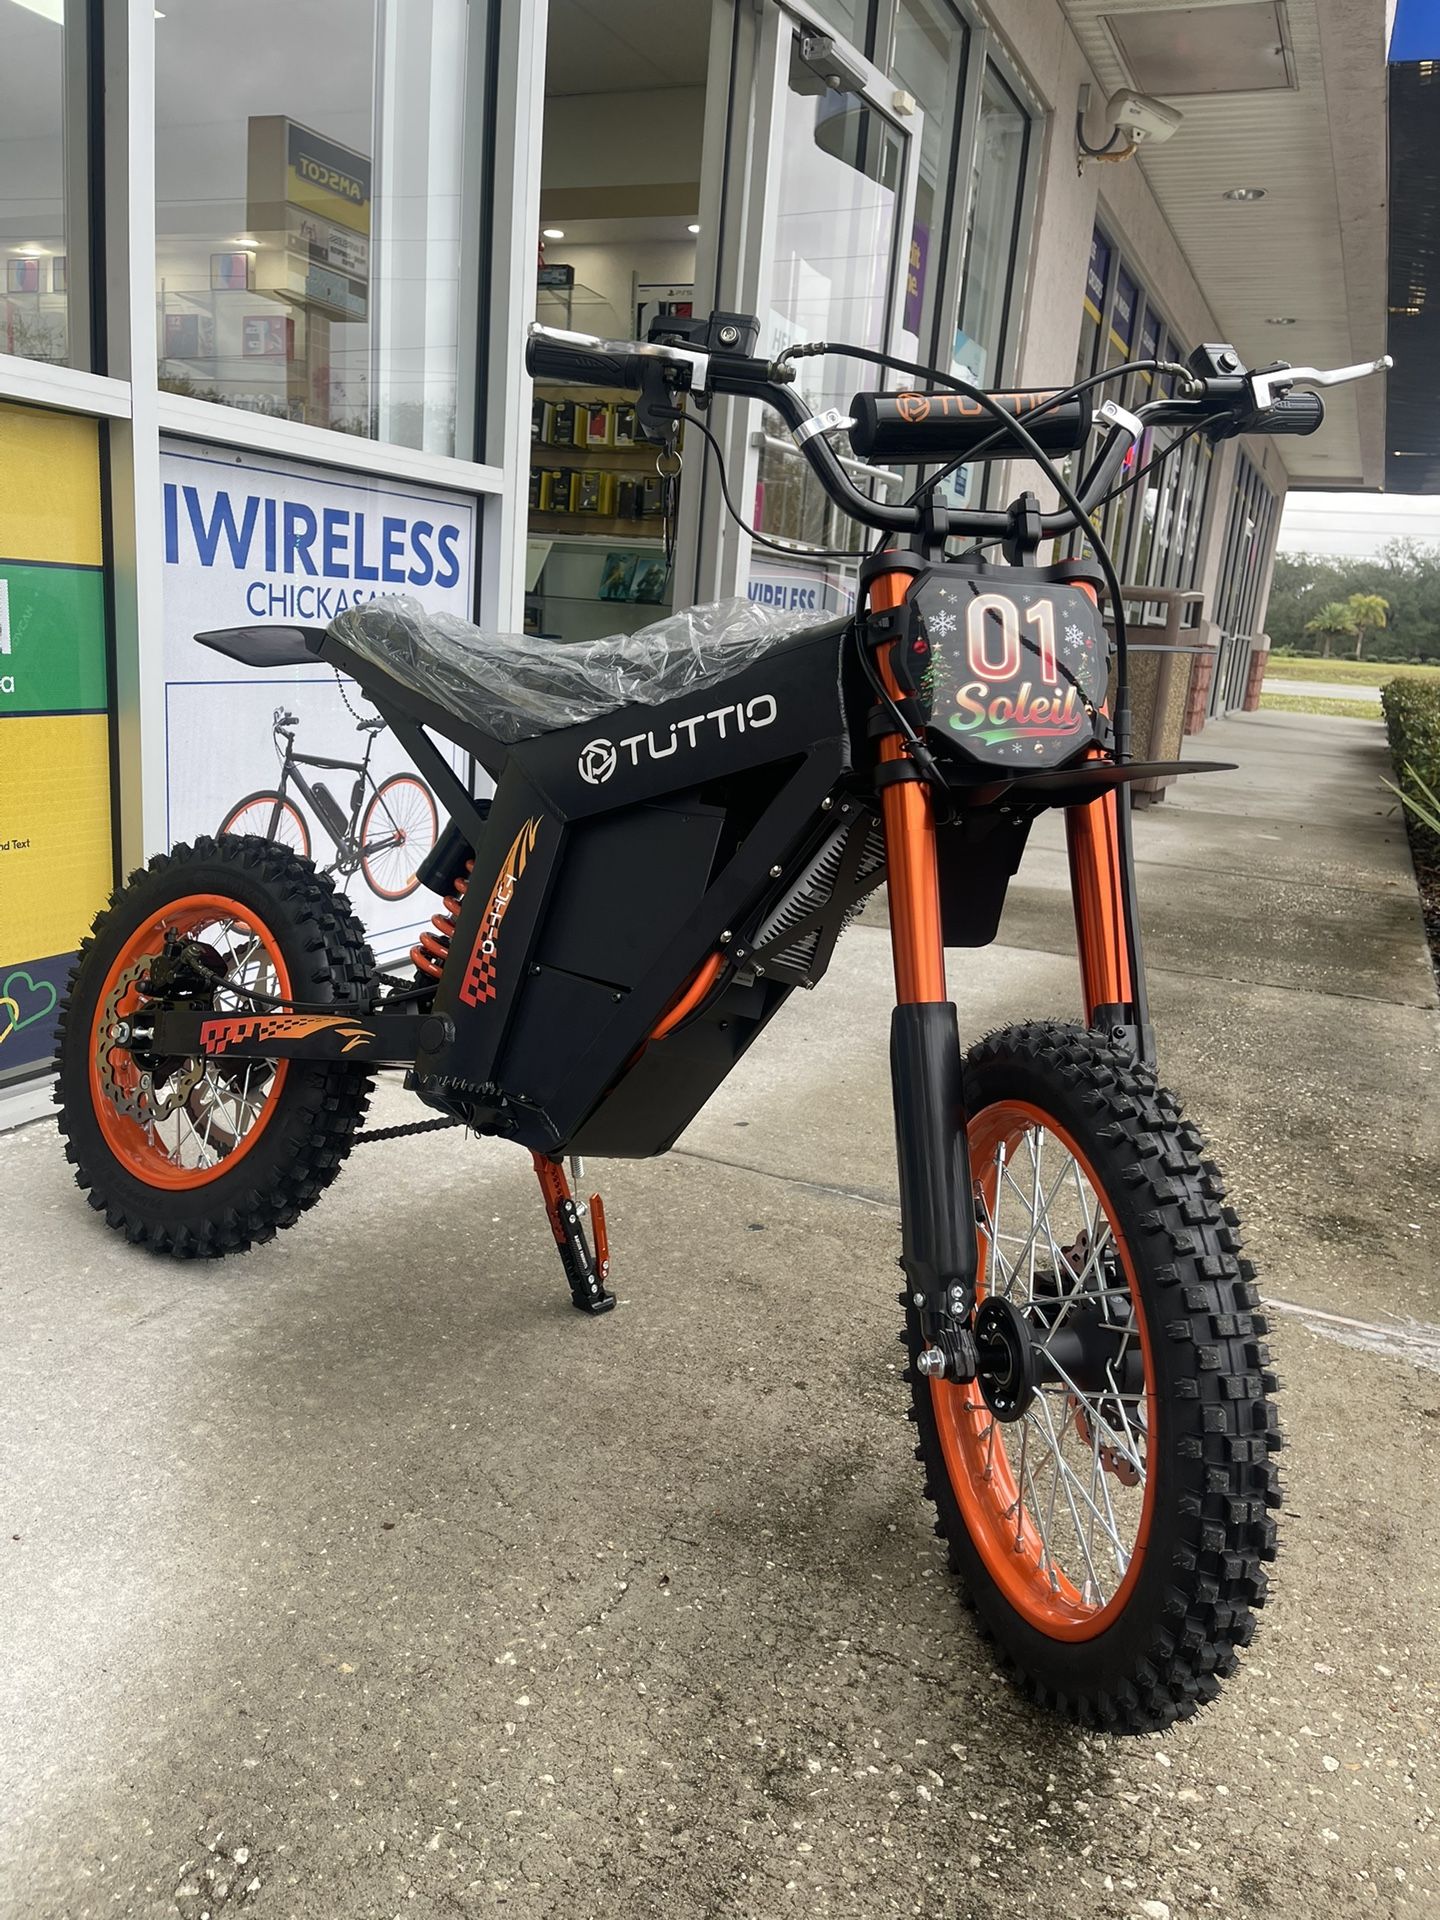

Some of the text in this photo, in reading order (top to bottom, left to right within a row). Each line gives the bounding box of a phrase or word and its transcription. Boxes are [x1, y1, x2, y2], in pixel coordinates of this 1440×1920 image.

[163, 483, 460, 589] IWIRELESS
[246, 582, 406, 619] CHICKAS
[966, 593, 1058, 684] 01
[948, 681, 1083, 732] Soleil
[11, 838, 31, 850] Text
